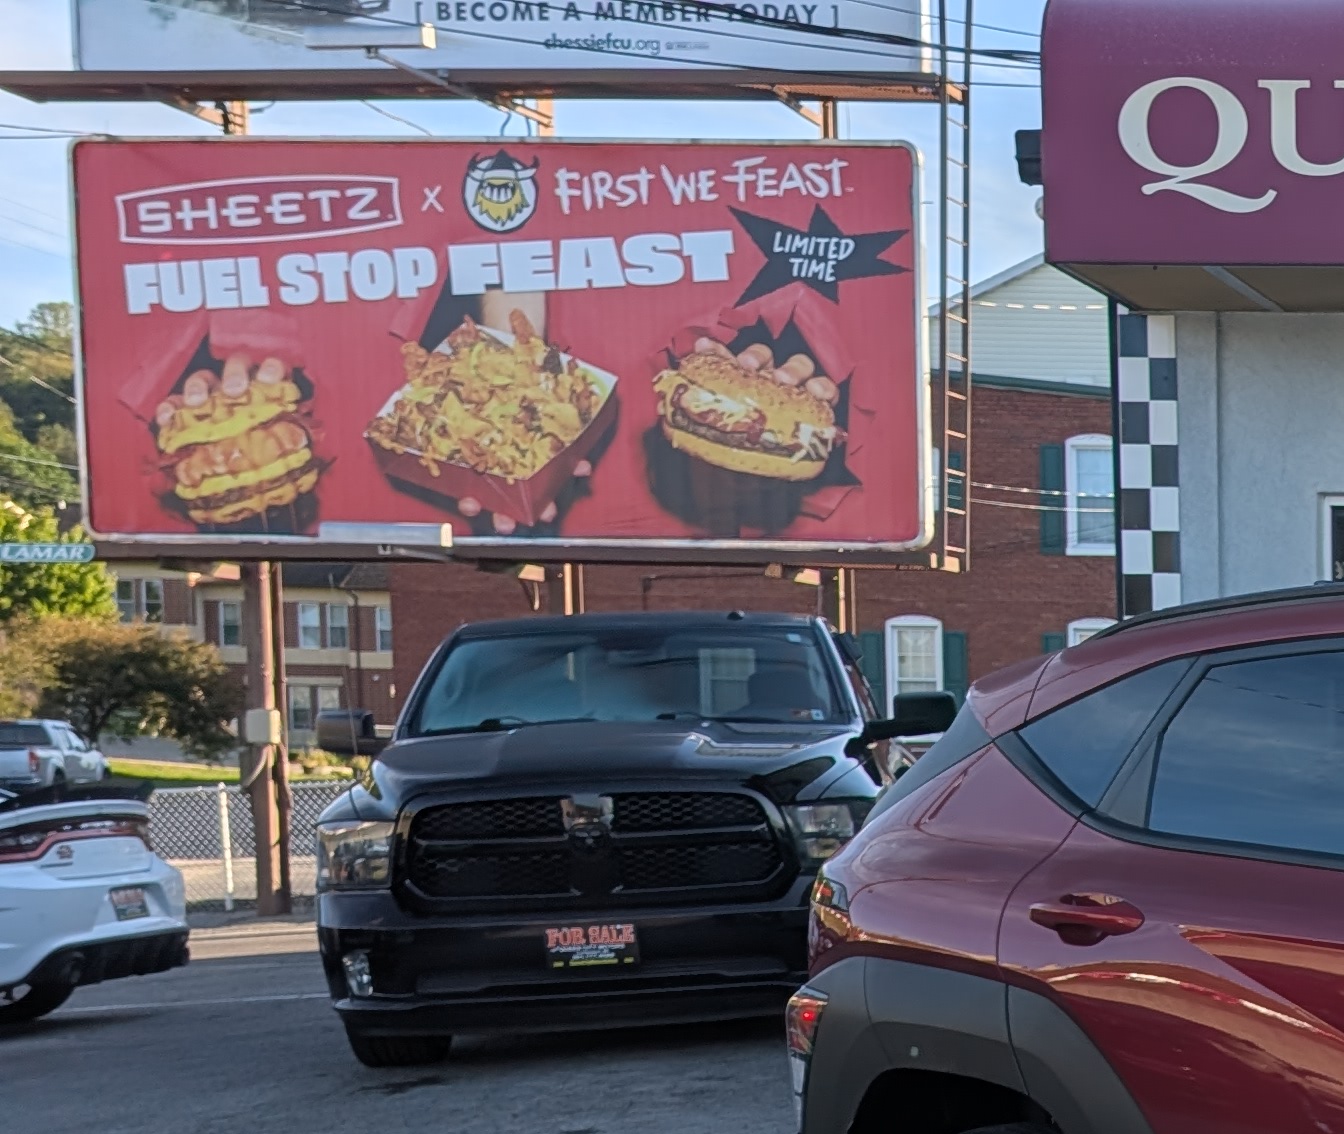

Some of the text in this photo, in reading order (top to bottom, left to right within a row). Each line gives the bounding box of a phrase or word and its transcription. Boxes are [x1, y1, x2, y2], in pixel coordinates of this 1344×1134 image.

[437, 2, 551, 22] BECOME
[563, 3, 581, 22] A
[594, 3, 711, 23] MEMBER
[543, 32, 661, 56] chessiefcu.org
[137, 187, 381, 234] SHEETZ
[554, 165, 656, 215] FIRST
[660, 163, 719, 206] WE
[722, 155, 849, 202] FEAST
[772, 231, 856, 261] LIMITED
[123, 229, 735, 315] FUEL STOP FEAST
[788, 257, 838, 283] TIME
[1, 545, 85, 560] LAMAR
[545, 928, 586, 948] FOR
[588, 924, 635, 944] SALE
